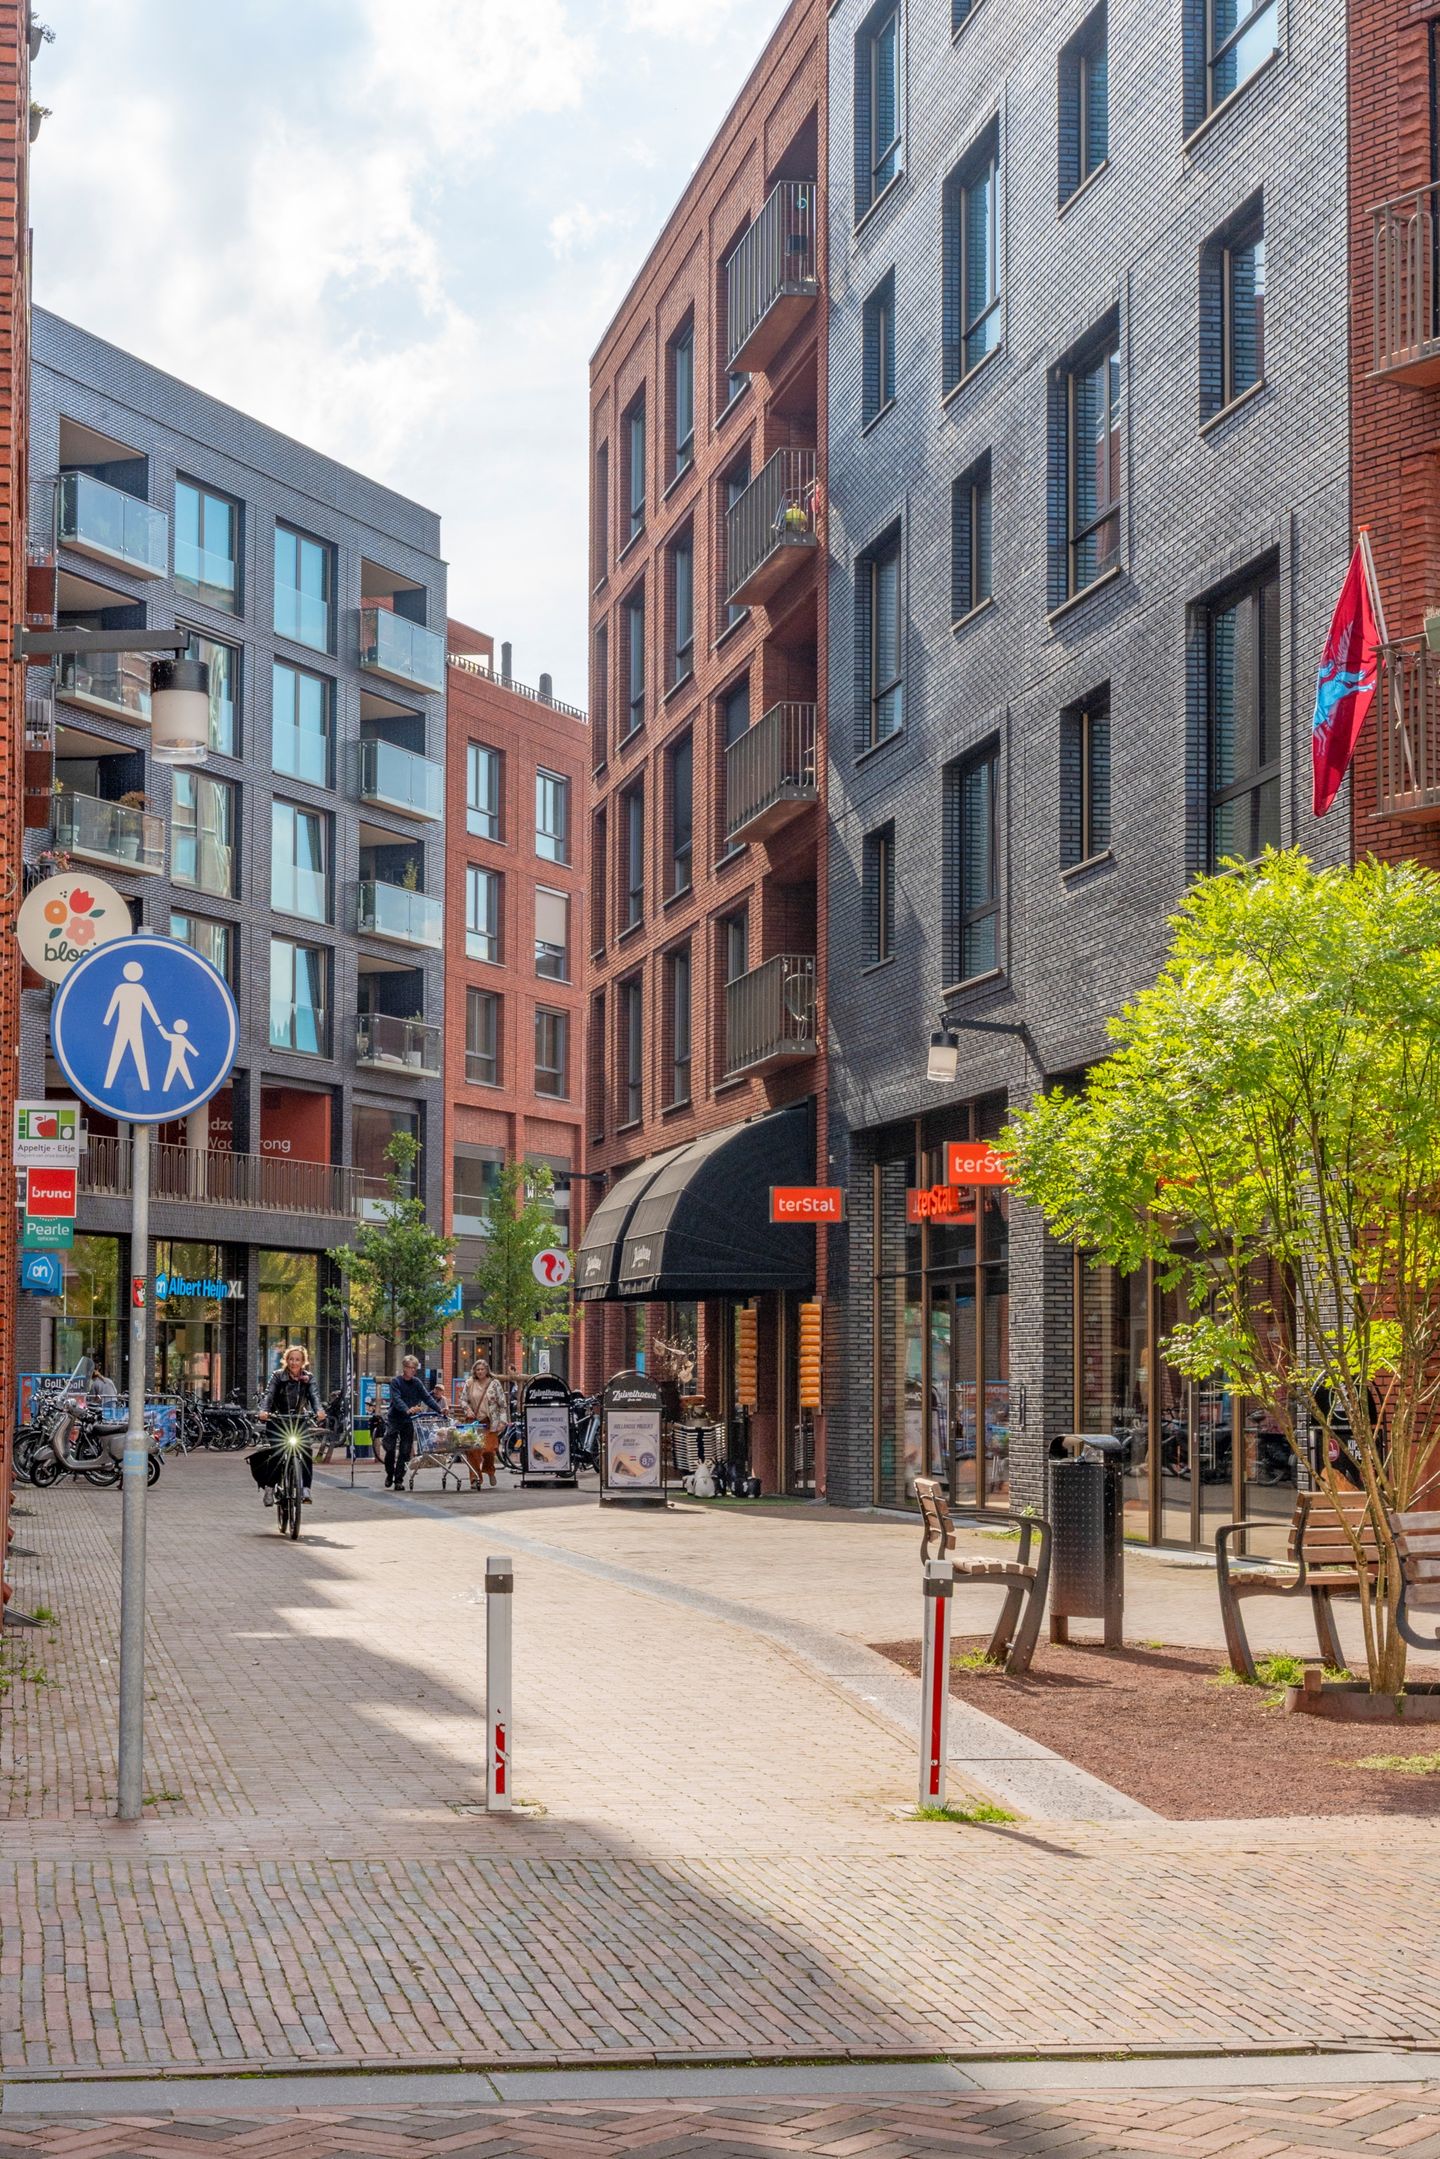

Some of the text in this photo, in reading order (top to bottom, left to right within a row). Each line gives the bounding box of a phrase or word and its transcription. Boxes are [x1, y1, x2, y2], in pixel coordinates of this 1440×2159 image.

[44, 941, 91, 962] blo
[17, 1144, 52, 1153] Appeltje
[57, 1144, 76, 1154] Eitje
[955, 1156, 1004, 1173] terSt
[32, 1186, 72, 1199] bruna
[778, 1197, 836, 1212] terStal
[917, 1185, 954, 1216] terStal
[27, 1223, 70, 1235] Pearle
[168, 1276, 202, 1296] Albert
[202, 1279, 228, 1302] Heijn
[228, 1280, 245, 1299] XL
[612, 1390, 657, 1401] Zuivelhoeve
